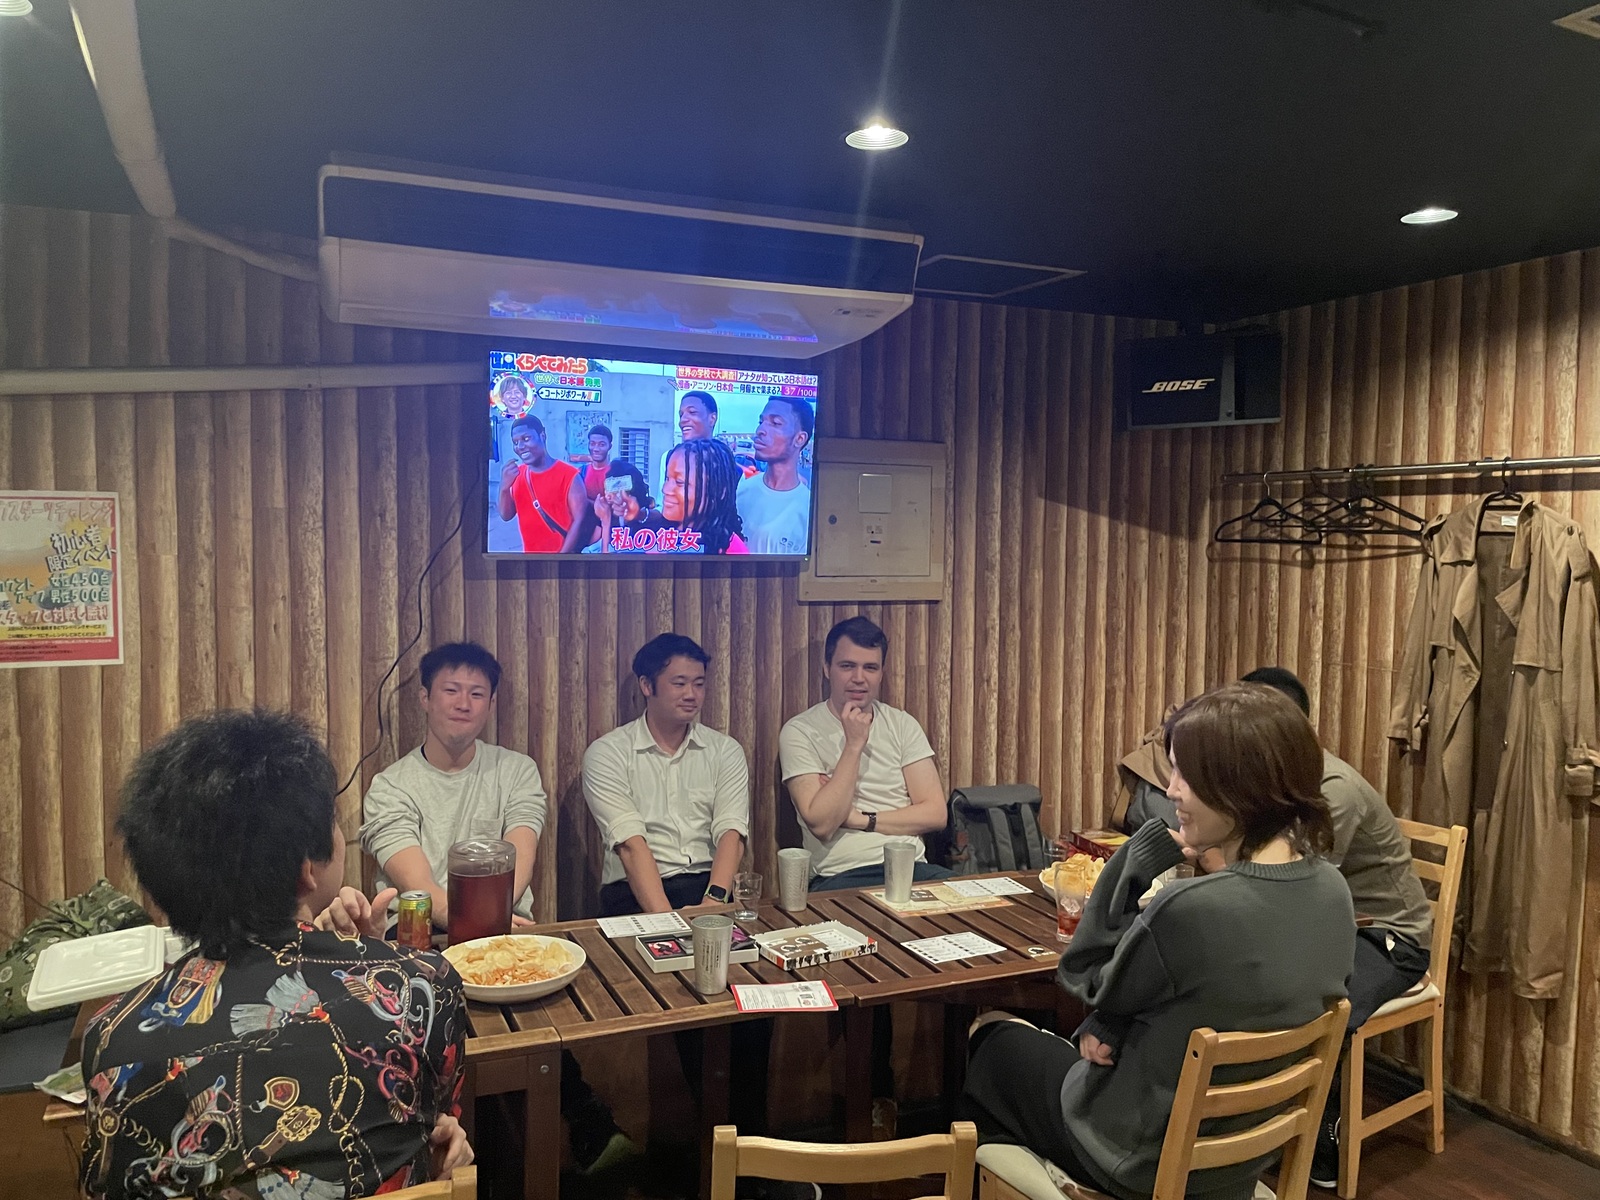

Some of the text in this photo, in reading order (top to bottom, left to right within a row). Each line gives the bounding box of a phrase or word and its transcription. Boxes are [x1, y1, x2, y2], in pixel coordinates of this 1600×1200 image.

[1142, 378, 1215, 393] BOSE
[51, 524, 102, 555] 初心者
[611, 527, 702, 551] 私の彼女
[46, 545, 117, 573] 限定イベント
